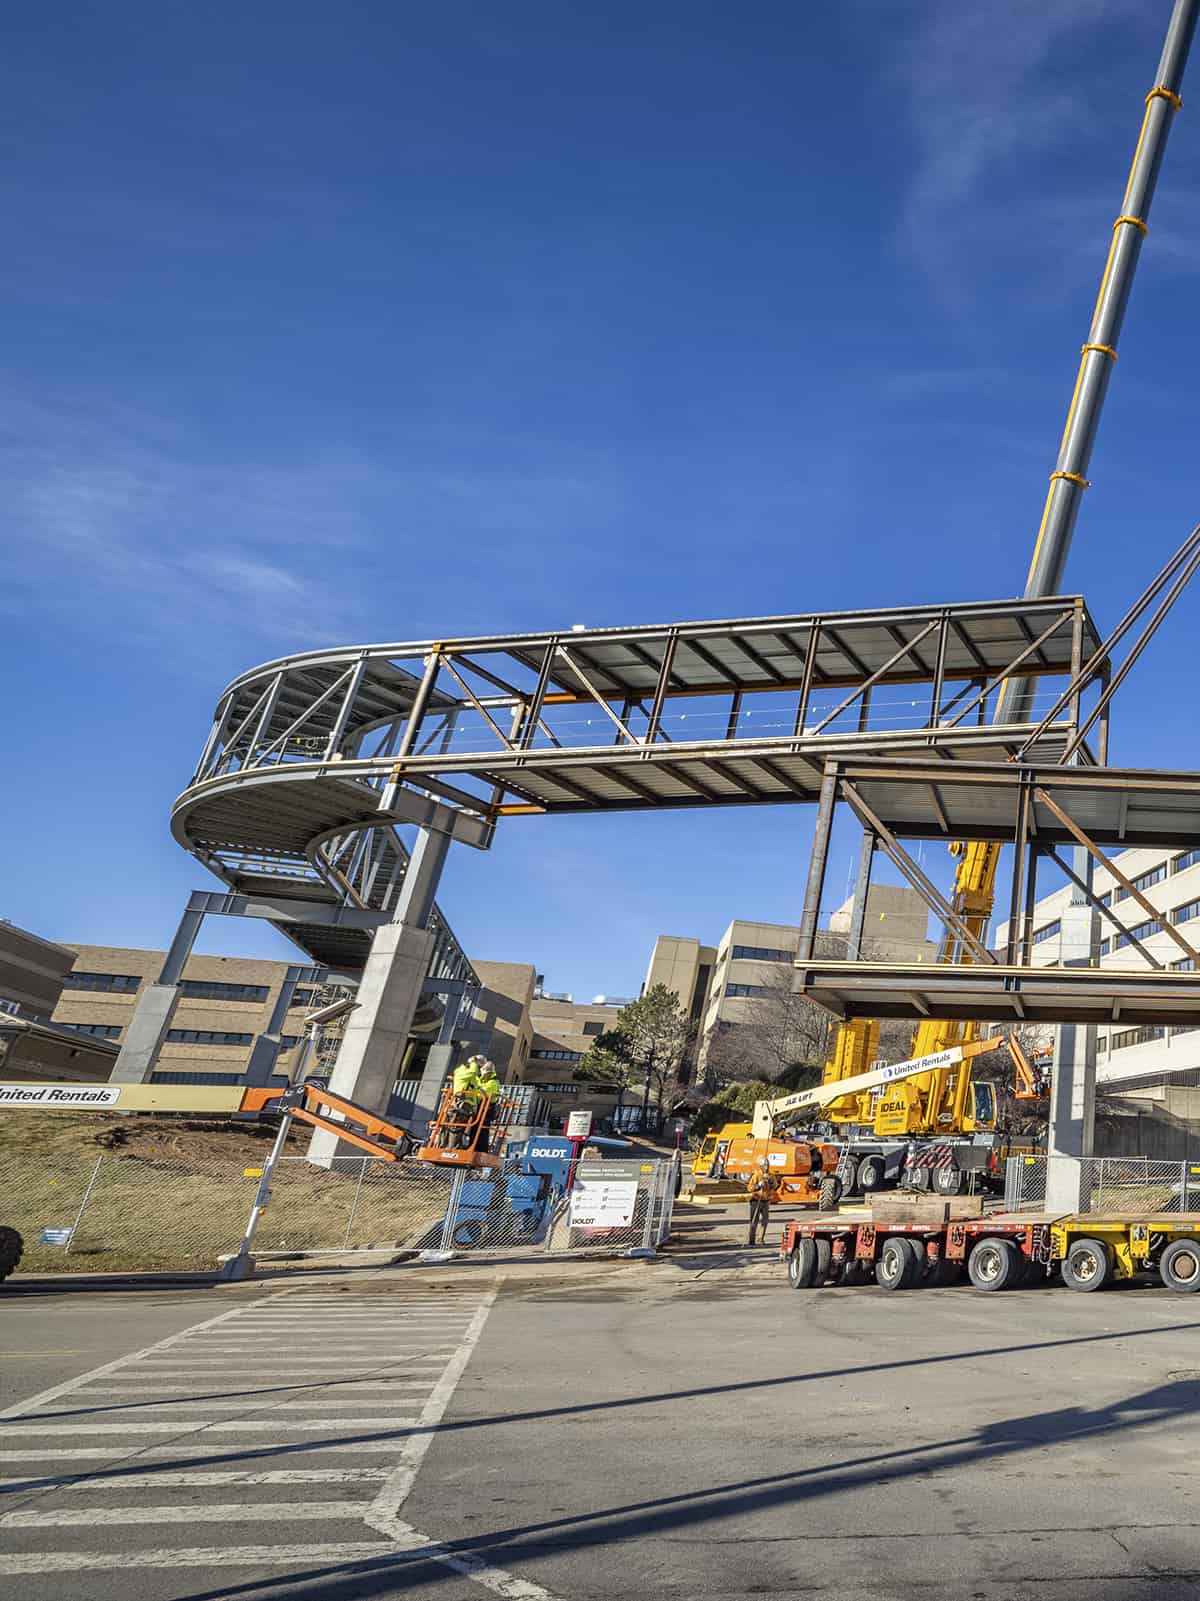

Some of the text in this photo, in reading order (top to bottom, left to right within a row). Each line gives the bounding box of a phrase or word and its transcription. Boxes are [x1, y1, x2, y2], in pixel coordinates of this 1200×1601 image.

[894, 1053, 951, 1076] United Rentals
[48, 1089, 111, 1101] Rentals
[880, 1101, 906, 1112] IDEAL
[531, 1149, 567, 1158] BOLDT
[572, 1217, 596, 1225] BOLDT
